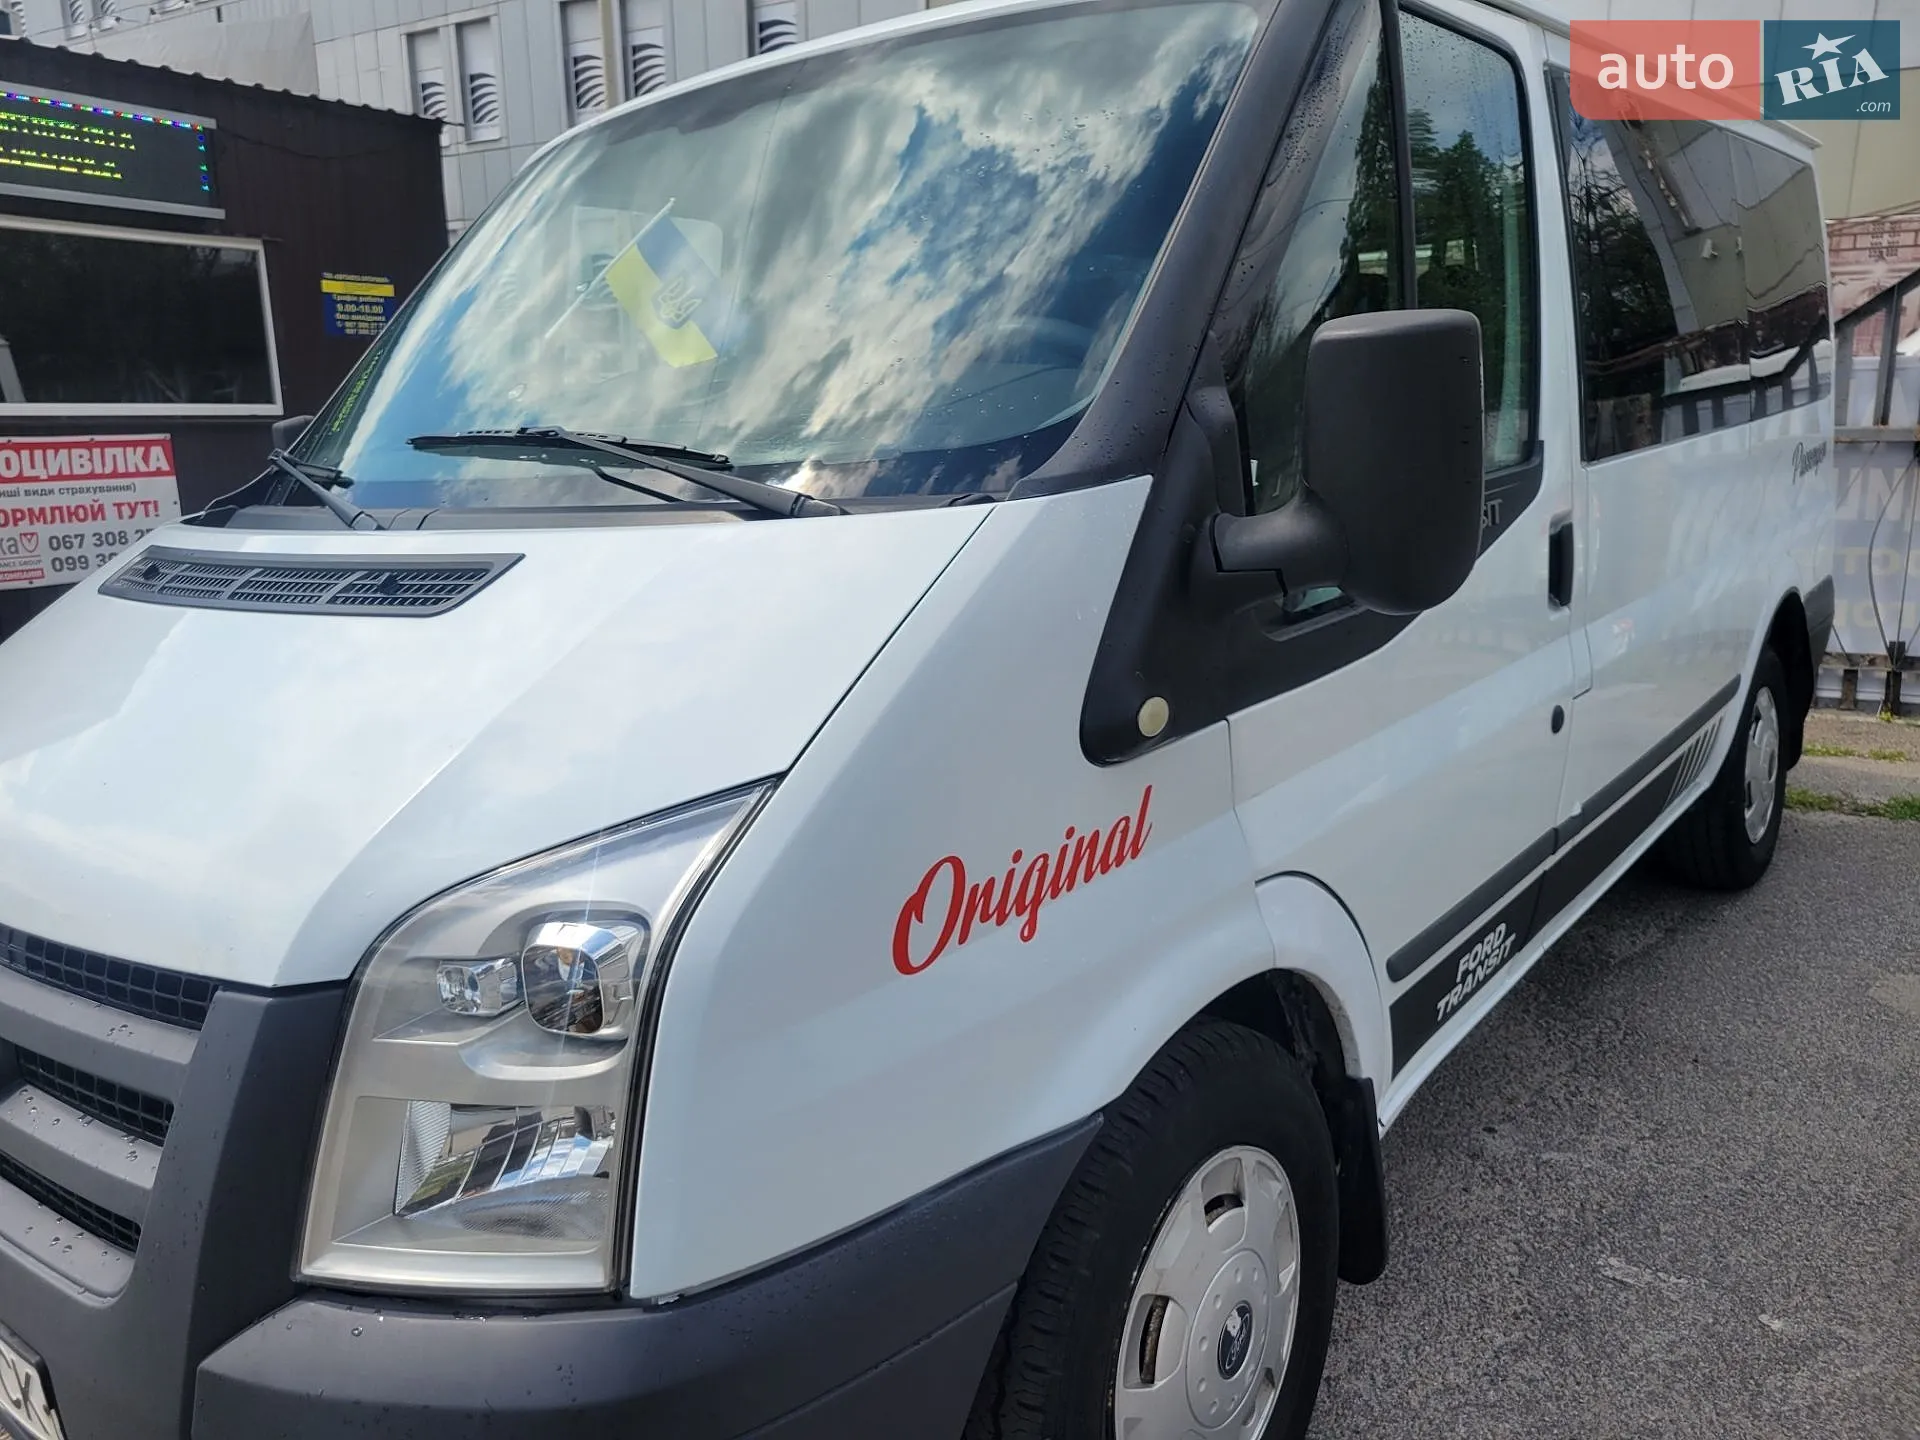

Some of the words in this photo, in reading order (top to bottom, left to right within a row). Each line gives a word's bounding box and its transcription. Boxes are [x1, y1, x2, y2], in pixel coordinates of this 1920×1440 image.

[0, 446, 170, 480] ОЦИВІЛКА
[113, 500, 160, 520] ТУТ!
[49, 533, 86, 551] 067
[92, 530, 129, 547] 308
[134, 528, 155, 543] 2
[51, 555, 90, 573] 099
[892, 784, 1153, 976] Original
[1456, 922, 1507, 983] FORD
[1436, 932, 1517, 1022] TRANSIT
